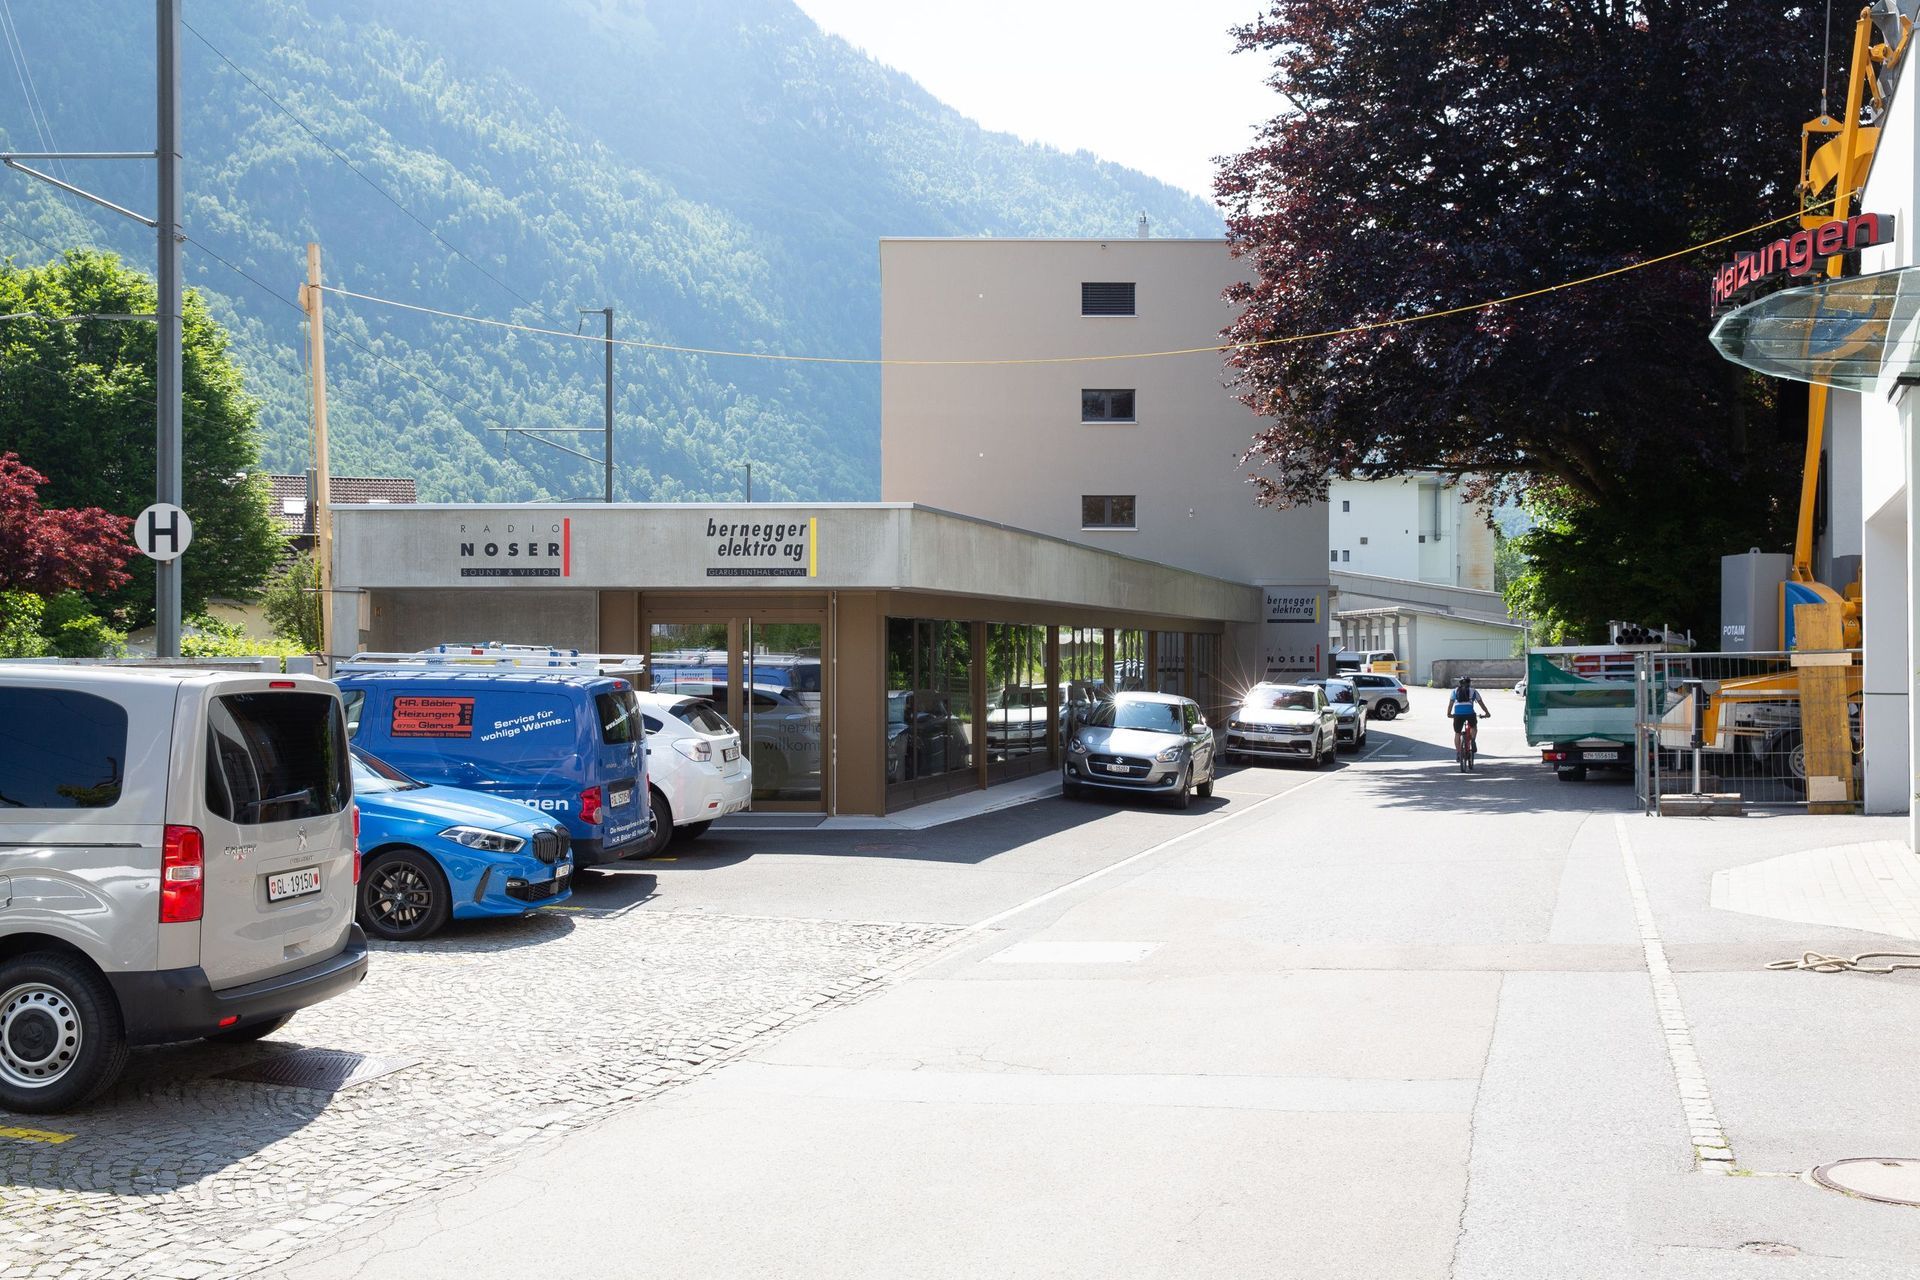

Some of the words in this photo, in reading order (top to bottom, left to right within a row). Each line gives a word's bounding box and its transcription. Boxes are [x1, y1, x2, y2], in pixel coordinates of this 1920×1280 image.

[1713, 212, 1880, 310] Heizungen
[148, 511, 179, 553] H
[460, 524, 560, 533] RADIO
[706, 518, 807, 542] bernegger
[460, 543, 560, 557] NOSER
[717, 537, 777, 557] elektro
[783, 543, 804, 562] ag
[462, 568, 501, 576] SOUND
[507, 568, 515, 576] &
[520, 568, 560, 576] VISION
[1266, 595, 1315, 607] bernegger
[1272, 605, 1301, 614] elektro
[1303, 606, 1314, 616] ag
[1723, 625, 1746, 635] POTAIN
[1266, 655, 1316, 664] NOSER
[397, 710, 455, 720] Heizungen
[494, 715, 535, 729] Service
[536, 710, 554, 720] für
[418, 721, 454, 729] Glarus
[480, 728, 521, 742] wohlige
